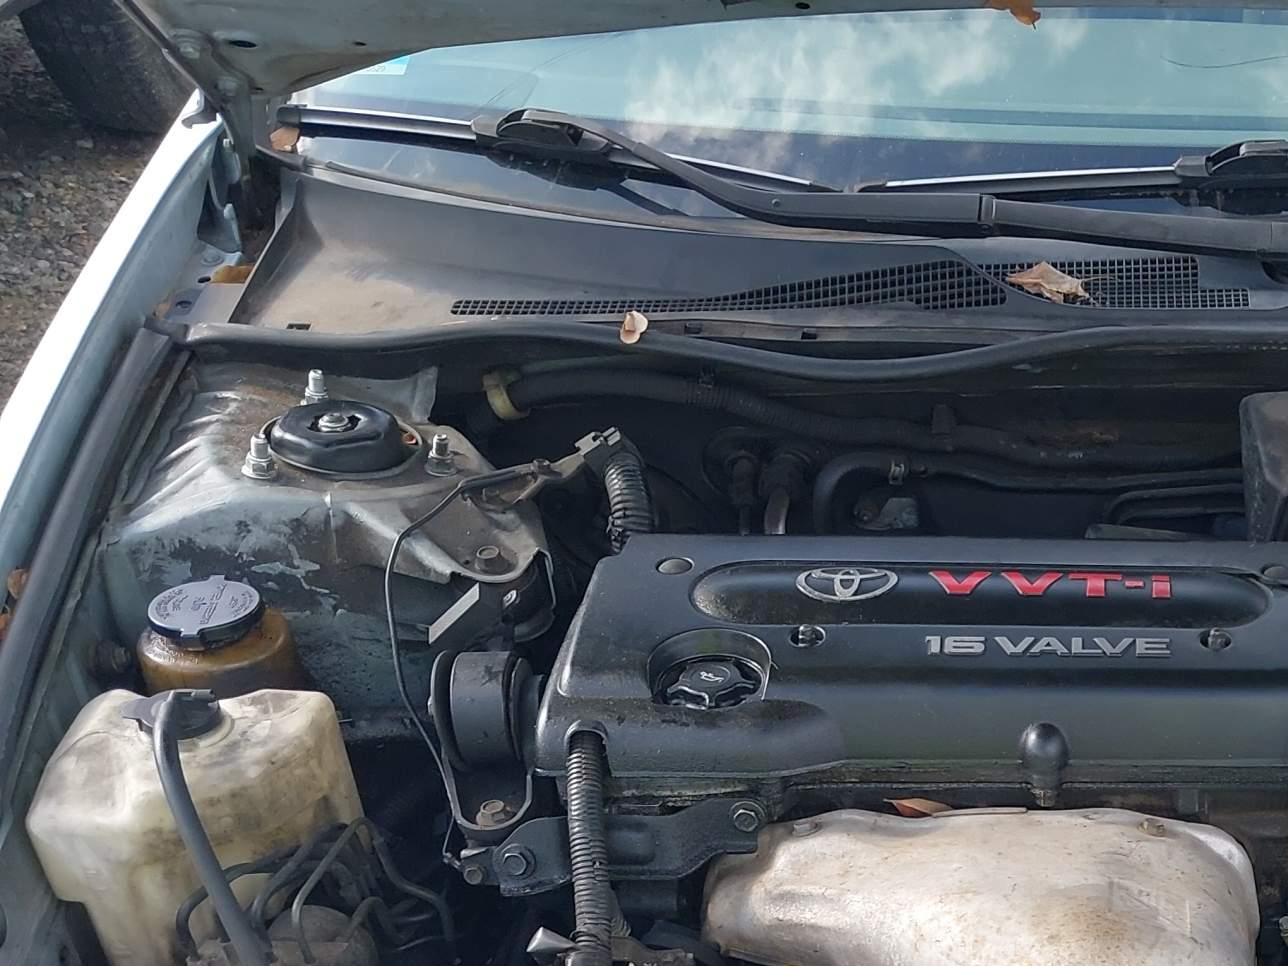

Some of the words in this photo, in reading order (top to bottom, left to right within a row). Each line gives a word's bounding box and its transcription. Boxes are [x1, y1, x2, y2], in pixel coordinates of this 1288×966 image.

[928, 570, 1172, 599] VVT-i
[924, 635, 986, 656] 16
[993, 636, 1172, 658] VALVE
